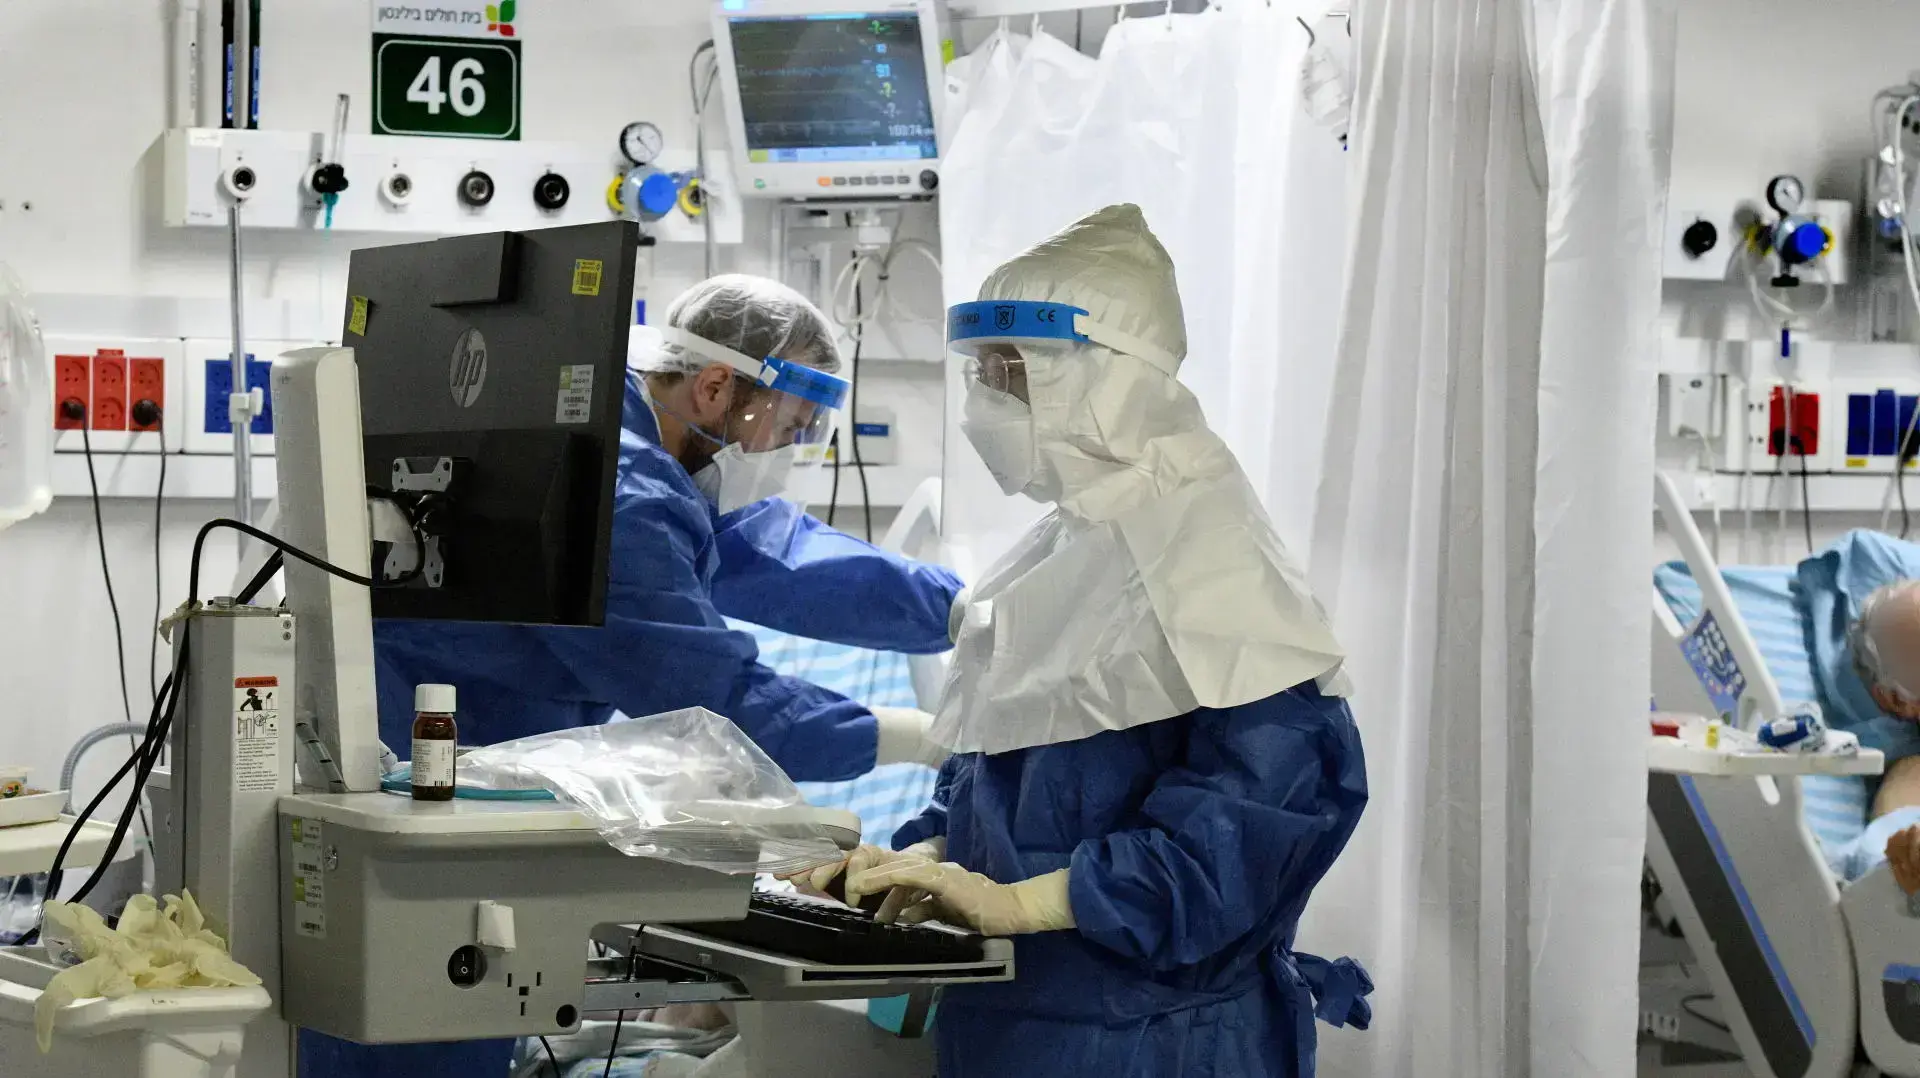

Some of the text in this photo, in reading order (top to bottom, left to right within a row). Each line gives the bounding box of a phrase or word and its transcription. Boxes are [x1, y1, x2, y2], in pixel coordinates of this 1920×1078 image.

[378, 5, 482, 24] בית חולים בילינסון
[407, 56, 486, 117] 46
[1037, 308, 1056, 322] CE
[450, 329, 486, 407] hp
